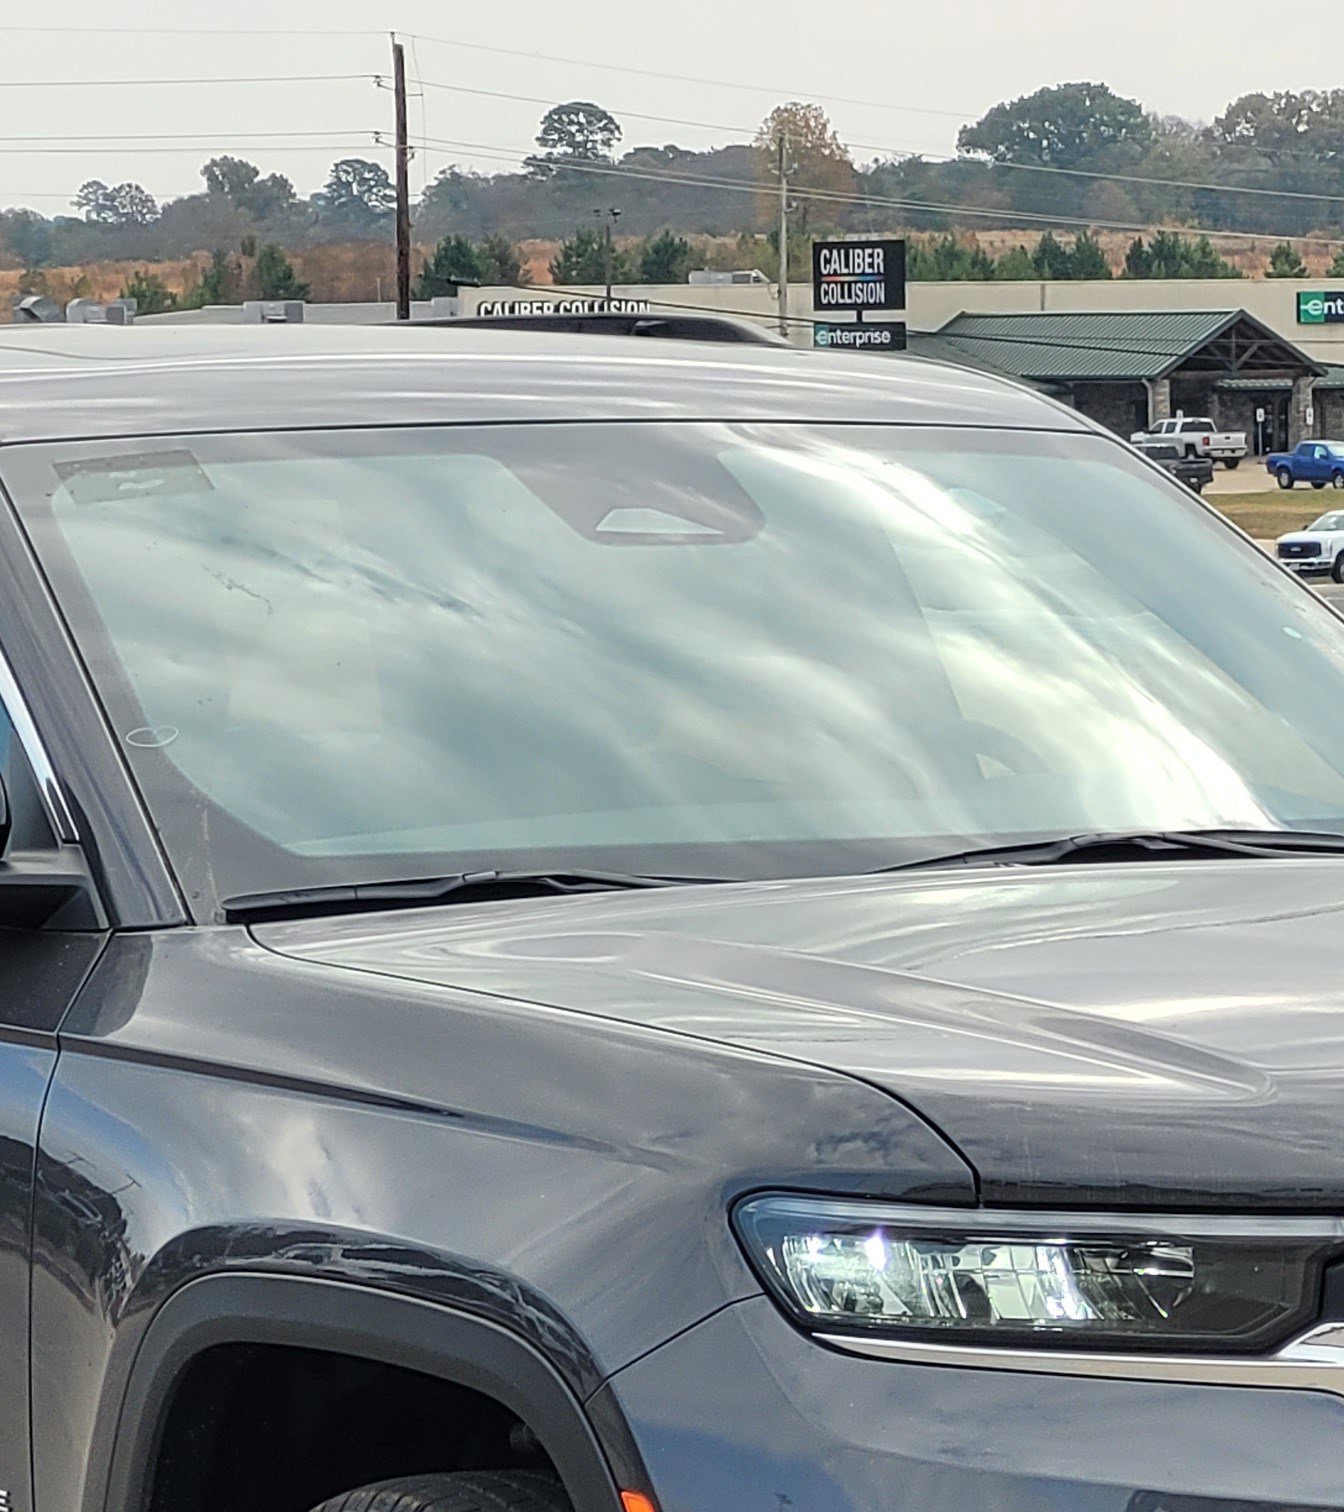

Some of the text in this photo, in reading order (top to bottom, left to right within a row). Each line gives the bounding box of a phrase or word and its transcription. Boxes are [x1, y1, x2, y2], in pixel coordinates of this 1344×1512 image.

[819, 248, 885, 275] CALIBER
[820, 281, 886, 305] COLLISION
[815, 328, 892, 348] enterprise
